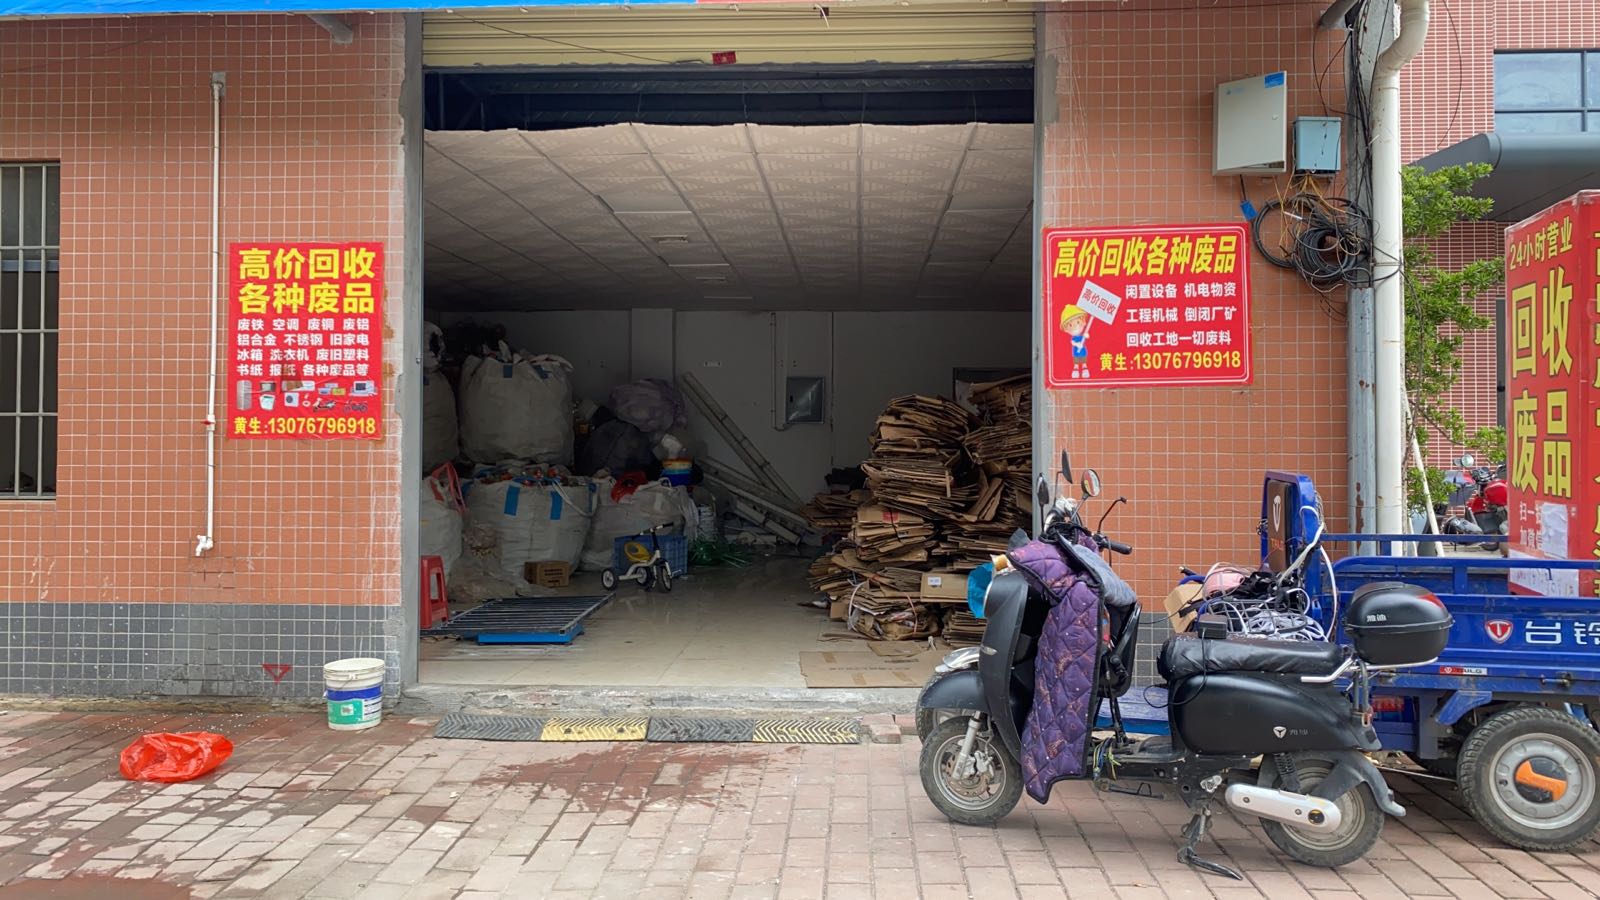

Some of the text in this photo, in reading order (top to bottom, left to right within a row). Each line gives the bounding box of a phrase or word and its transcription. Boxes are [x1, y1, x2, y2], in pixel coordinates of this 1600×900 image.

[1509, 216, 1573, 270] 24小时营业
[239, 248, 375, 279] 高价回收
[1054, 235, 1237, 277] 高价回收各种废品
[239, 282, 374, 314] 各种废品
[1082, 287, 1116, 316] 高价回收
[1125, 281, 1236, 299] 闲置设备 机电物资
[237, 317, 370, 331] 废铁 空调 废铜 废铝
[1126, 305, 1237, 323] 工程机械 倒闭厂矿
[1511, 265, 1573, 379] 回收
[237, 332, 369, 346] 铝合金 不锈钢 旧家电
[1126, 329, 1232, 348] 回收工地一切废料
[236, 348, 370, 362] 冰箱 洗衣机 废旧塑料
[236, 363, 369, 377] 书纸 报纸 各种废品等
[1511, 390, 1572, 497] 废品
